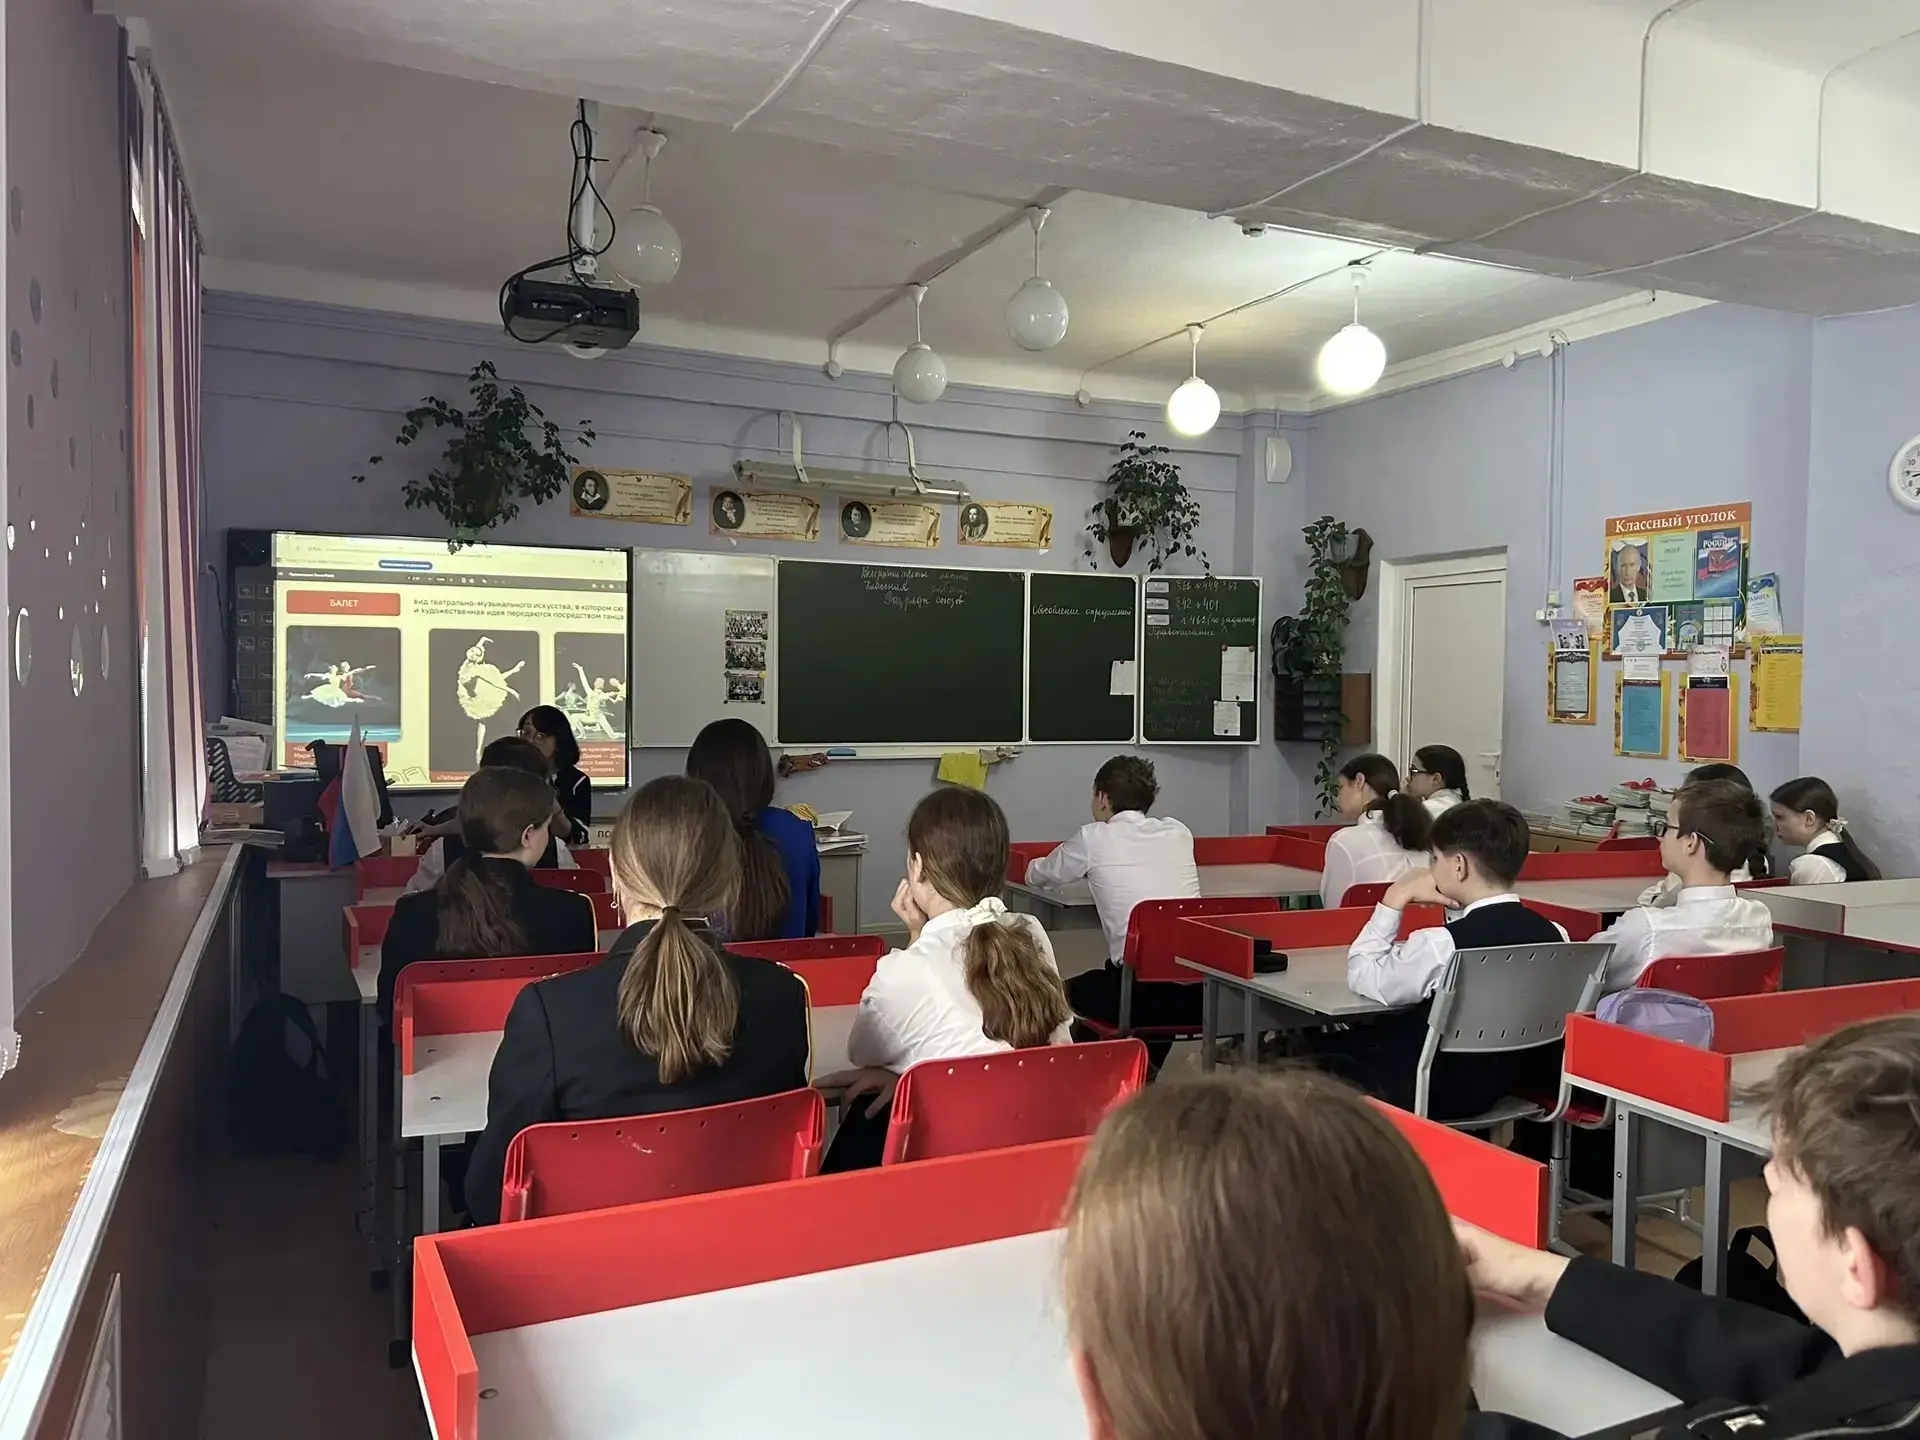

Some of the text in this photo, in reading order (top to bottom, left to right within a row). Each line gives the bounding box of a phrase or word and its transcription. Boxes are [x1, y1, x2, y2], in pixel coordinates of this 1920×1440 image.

[1907, 458, 1916, 466] 10
[1615, 510, 1736, 533] Классный уголок
[330, 599, 359, 607] БАЛЕТ
[430, 599, 532, 610] театрально-музыкального
[533, 603, 573, 611] искусства,
[421, 608, 485, 616] художественная
[506, 611, 551, 619] передаются
[553, 612, 601, 620] посредством
[1032, 604, 1080, 615] Обособление
[1085, 607, 1133, 623] определений
